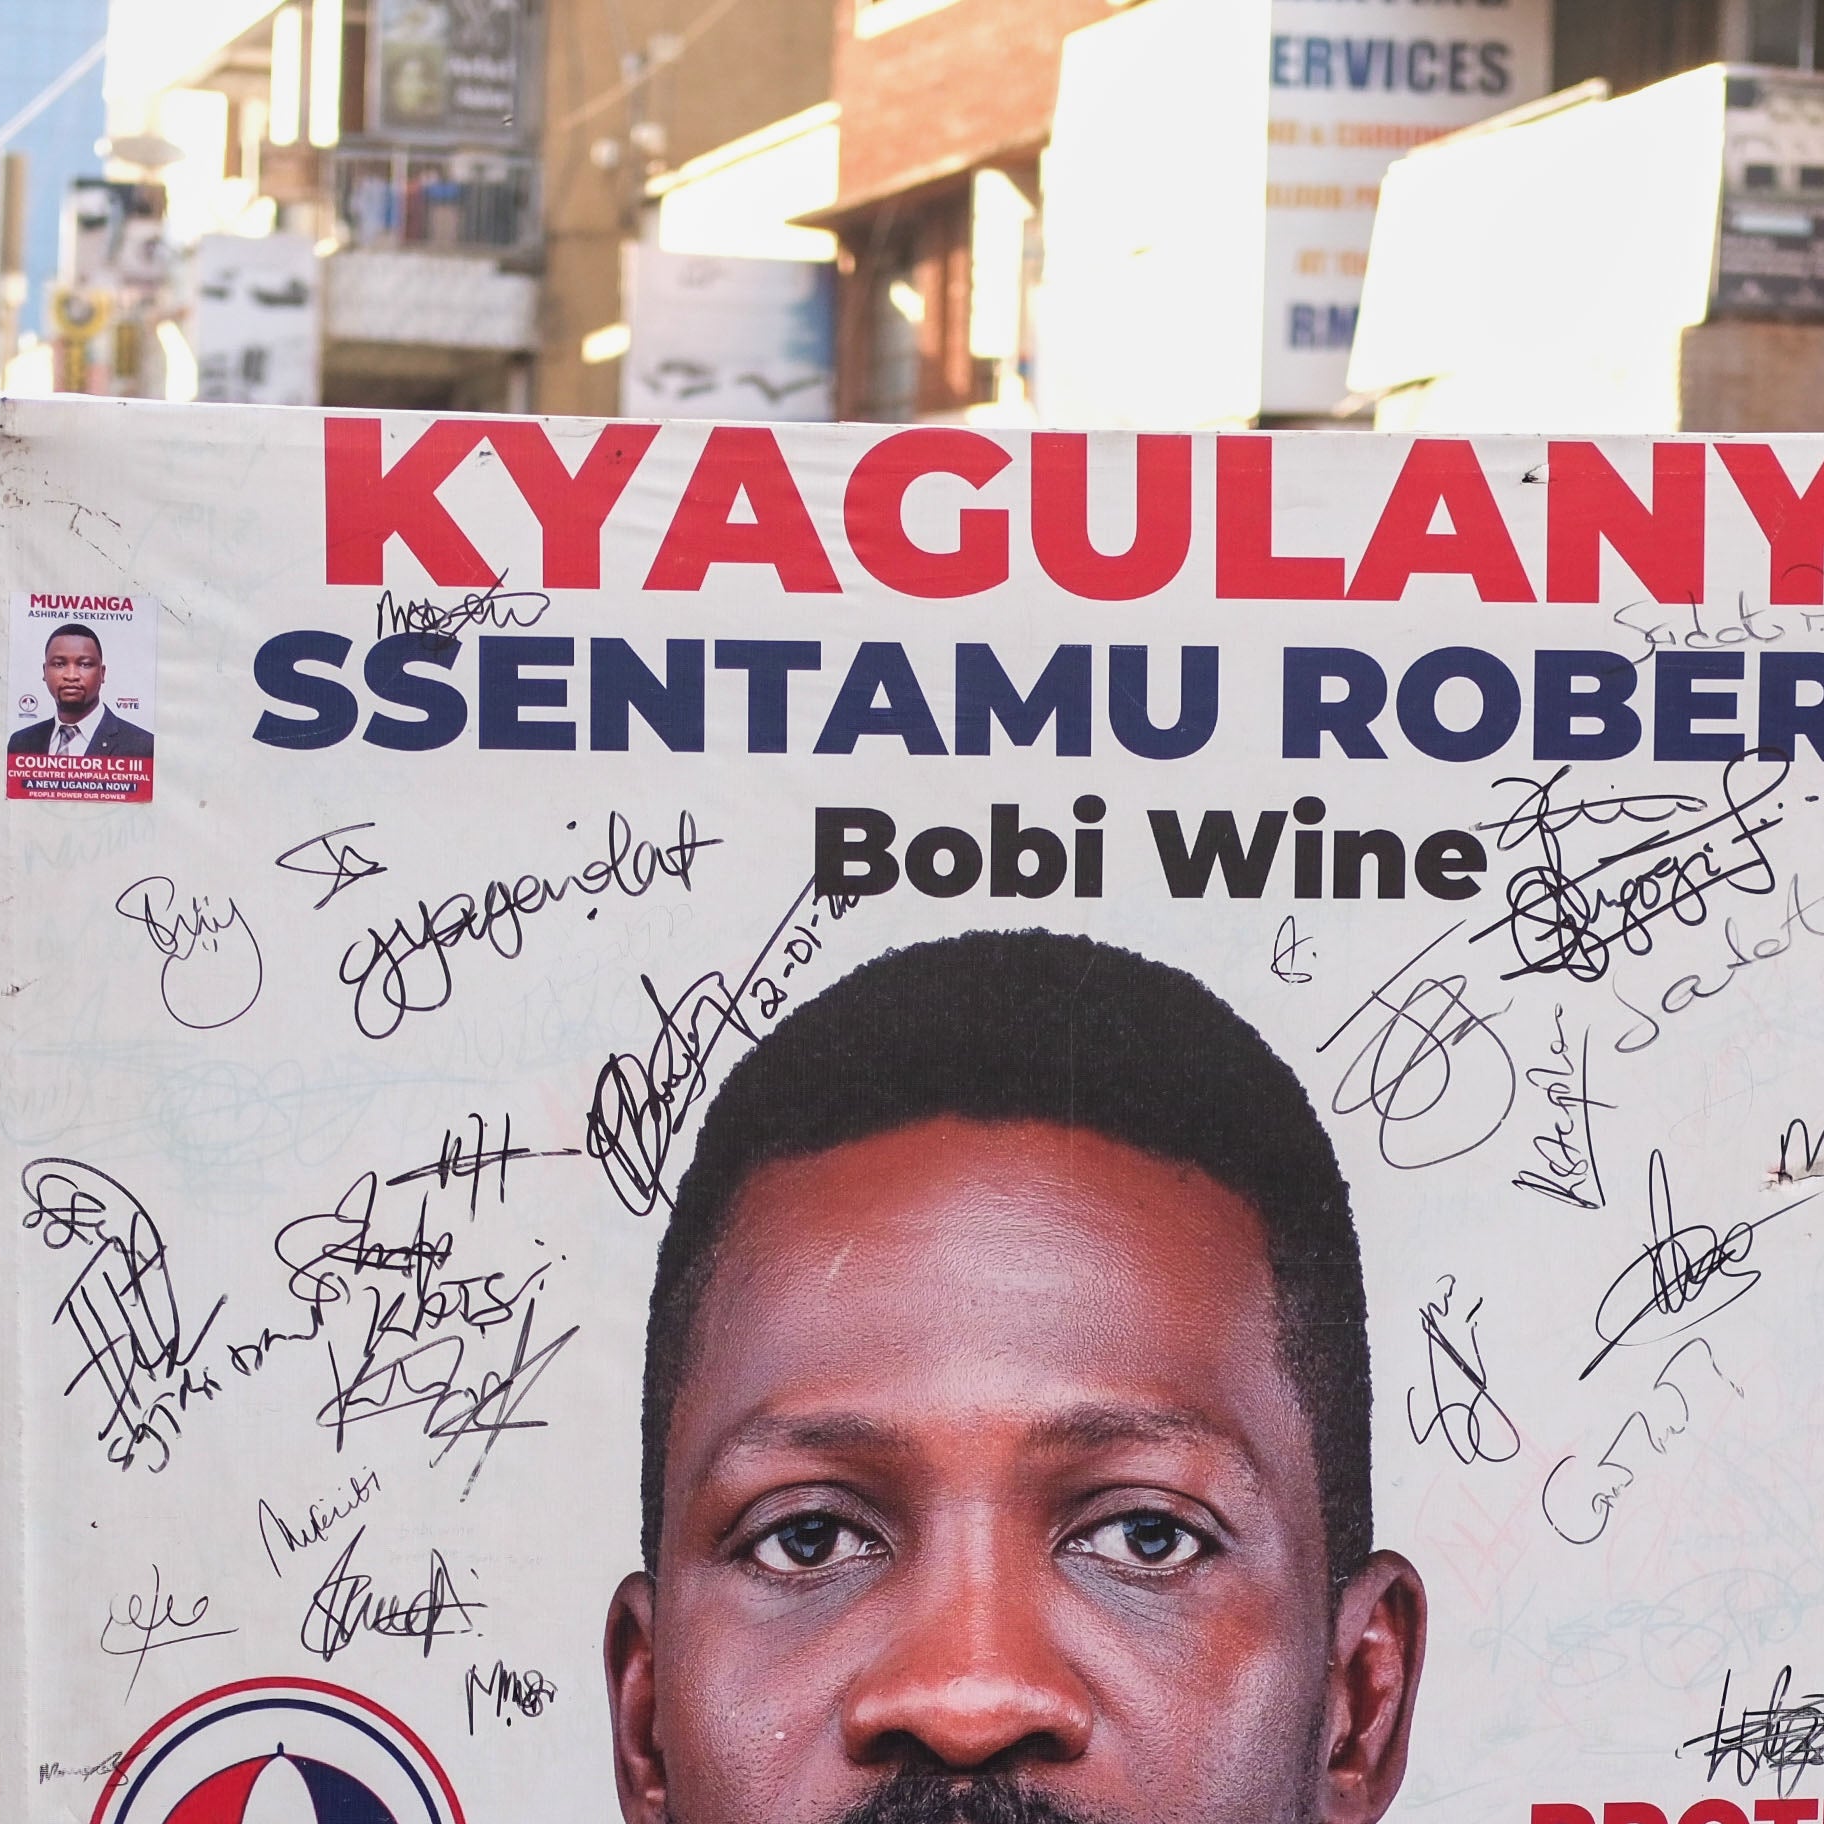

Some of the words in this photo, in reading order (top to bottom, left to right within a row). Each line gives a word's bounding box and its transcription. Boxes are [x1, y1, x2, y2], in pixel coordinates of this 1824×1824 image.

[30, 593, 134, 612] MUWANGA
[28, 610, 70, 620] ASHIRAF
[73, 611, 133, 622] SSEKIZIYIVU
[251, 629, 1219, 760] SSENTAMU
[15, 755, 103, 771] COUNCILOR
[107, 758, 125, 771] LC
[129, 760, 143, 772] III
[8, 769, 31, 778] CIVIC
[32, 770, 66, 779] CENTRE
[67, 771, 110, 781] KAMPALA
[111, 773, 150, 782] CENTRAL
[26, 780, 34, 788] A
[36, 780, 59, 789] NEW
[62, 781, 104, 790] UGANDA
[106, 782, 130, 791] NOW
[29, 791, 55, 799] PEOPLE
[84, 792, 99, 800] OUR
[813, 794, 1108, 899] Bobi
[1146, 795, 1488, 901] Wine
